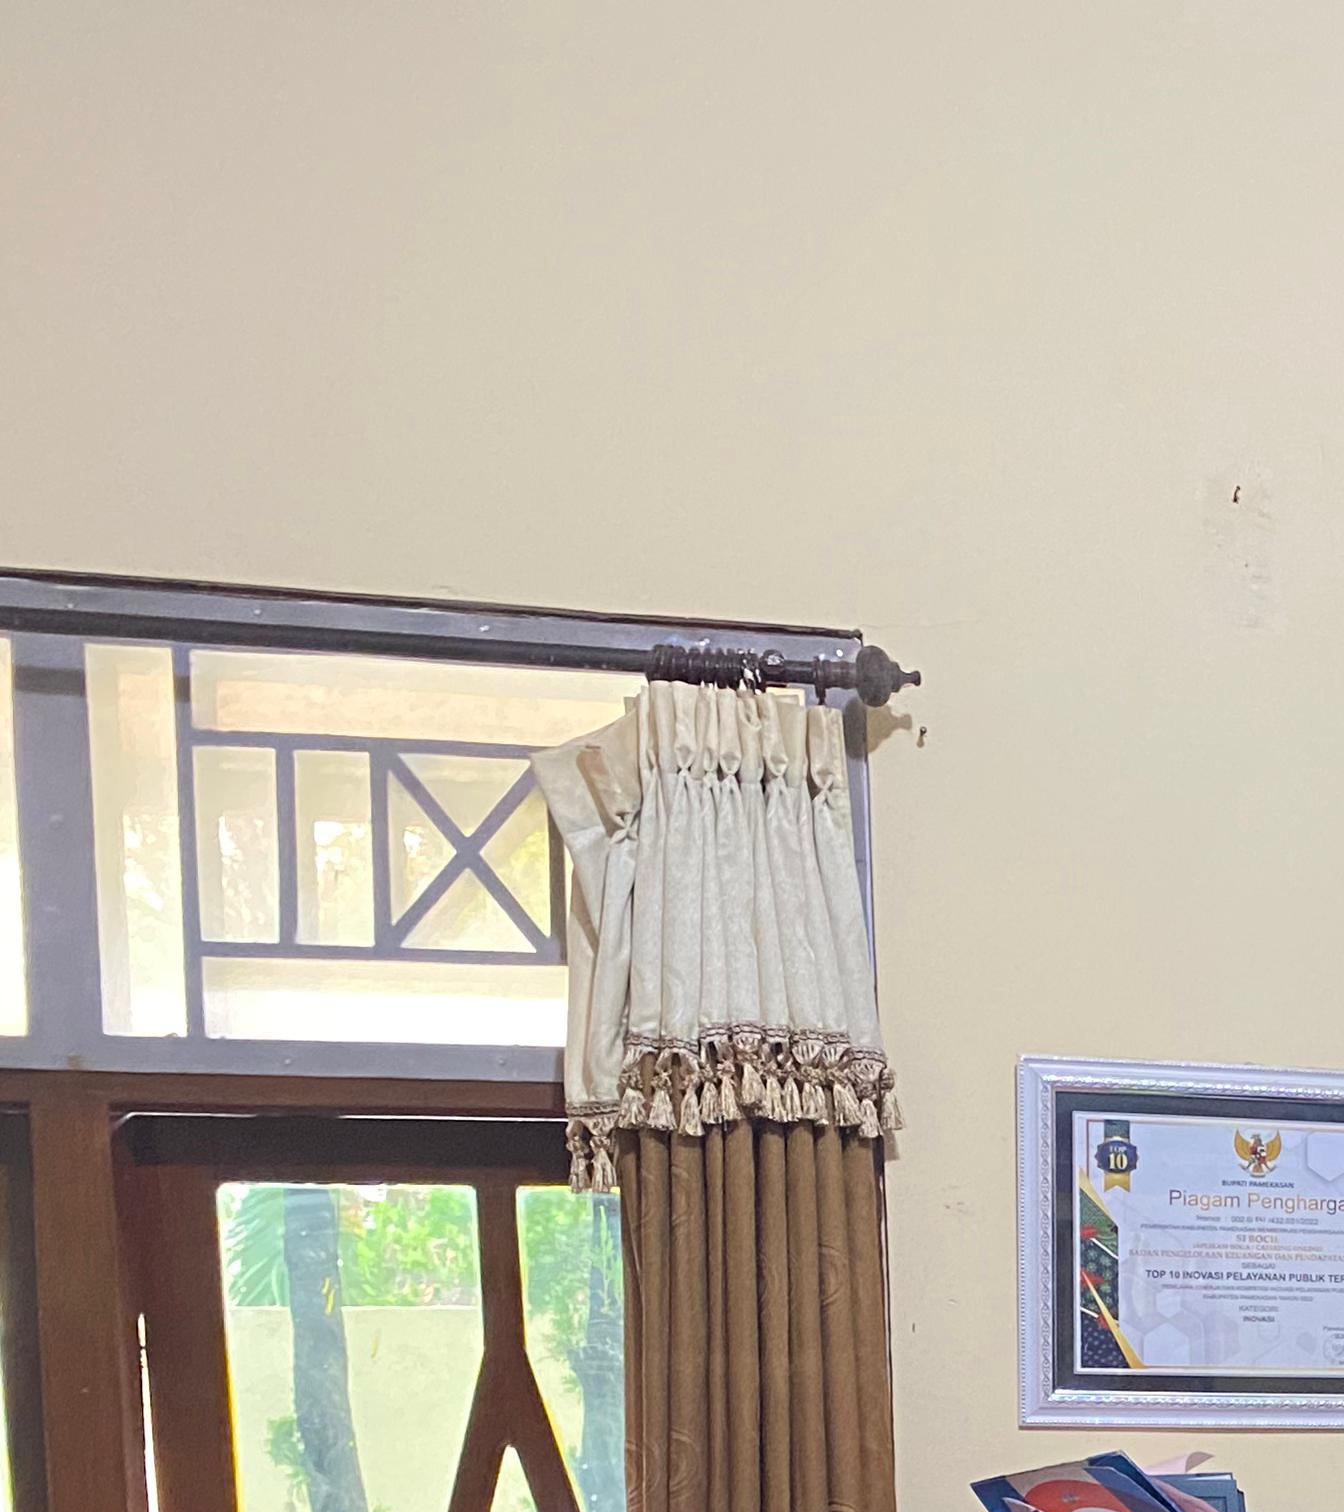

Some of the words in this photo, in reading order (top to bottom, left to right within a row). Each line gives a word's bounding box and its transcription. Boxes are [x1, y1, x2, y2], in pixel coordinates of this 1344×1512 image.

[1109, 1153, 1128, 1169] 10
[1169, 1189, 1240, 1211] Piagam
[1145, 1270, 1166, 1278] TOP
[1183, 1271, 1223, 1279] INOVASI
[1226, 1272, 1286, 1281] PELAYANAN
[1289, 1273, 1325, 1282] PUBLIK
